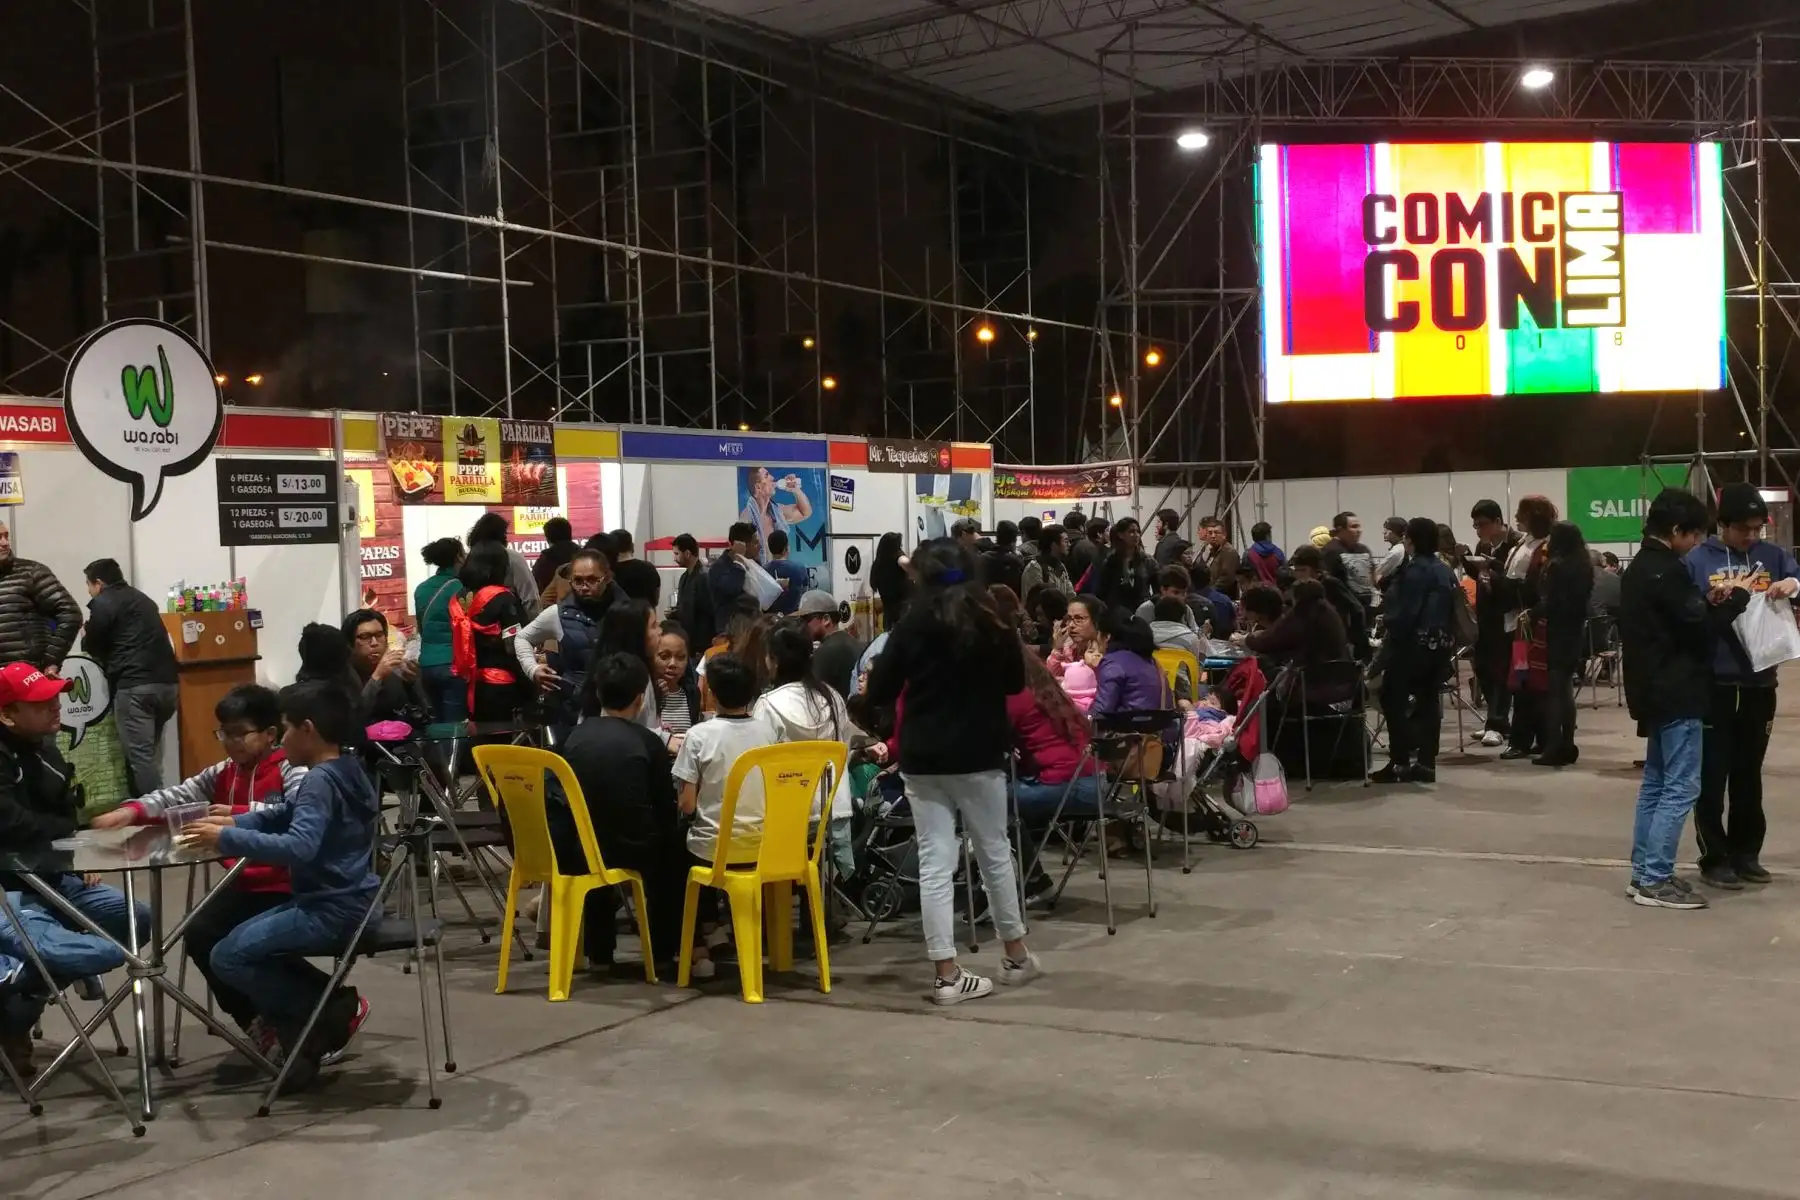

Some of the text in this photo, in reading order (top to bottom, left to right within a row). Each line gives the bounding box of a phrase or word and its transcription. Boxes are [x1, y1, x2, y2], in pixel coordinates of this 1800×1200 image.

[1363, 191, 1555, 245] COMIC
[1564, 194, 1621, 325] LIMA
[1364, 247, 1557, 333] CON
[384, 416, 553, 444] PEPE PARRILLA
[123, 429, 179, 445] wasabi
[869, 445, 885, 462] Mr.
[458, 464, 486, 475] PEPE
[230, 474, 236, 482] 6
[237, 474, 263, 482] PIEZAS
[449, 475, 496, 486] PARRILLA
[237, 485, 273, 494] GASEOSA
[834, 493, 850, 504] VISA
[230, 508, 240, 517] 12
[241, 508, 268, 517] PIEZAS
[239, 520, 275, 529] GASEOSA
